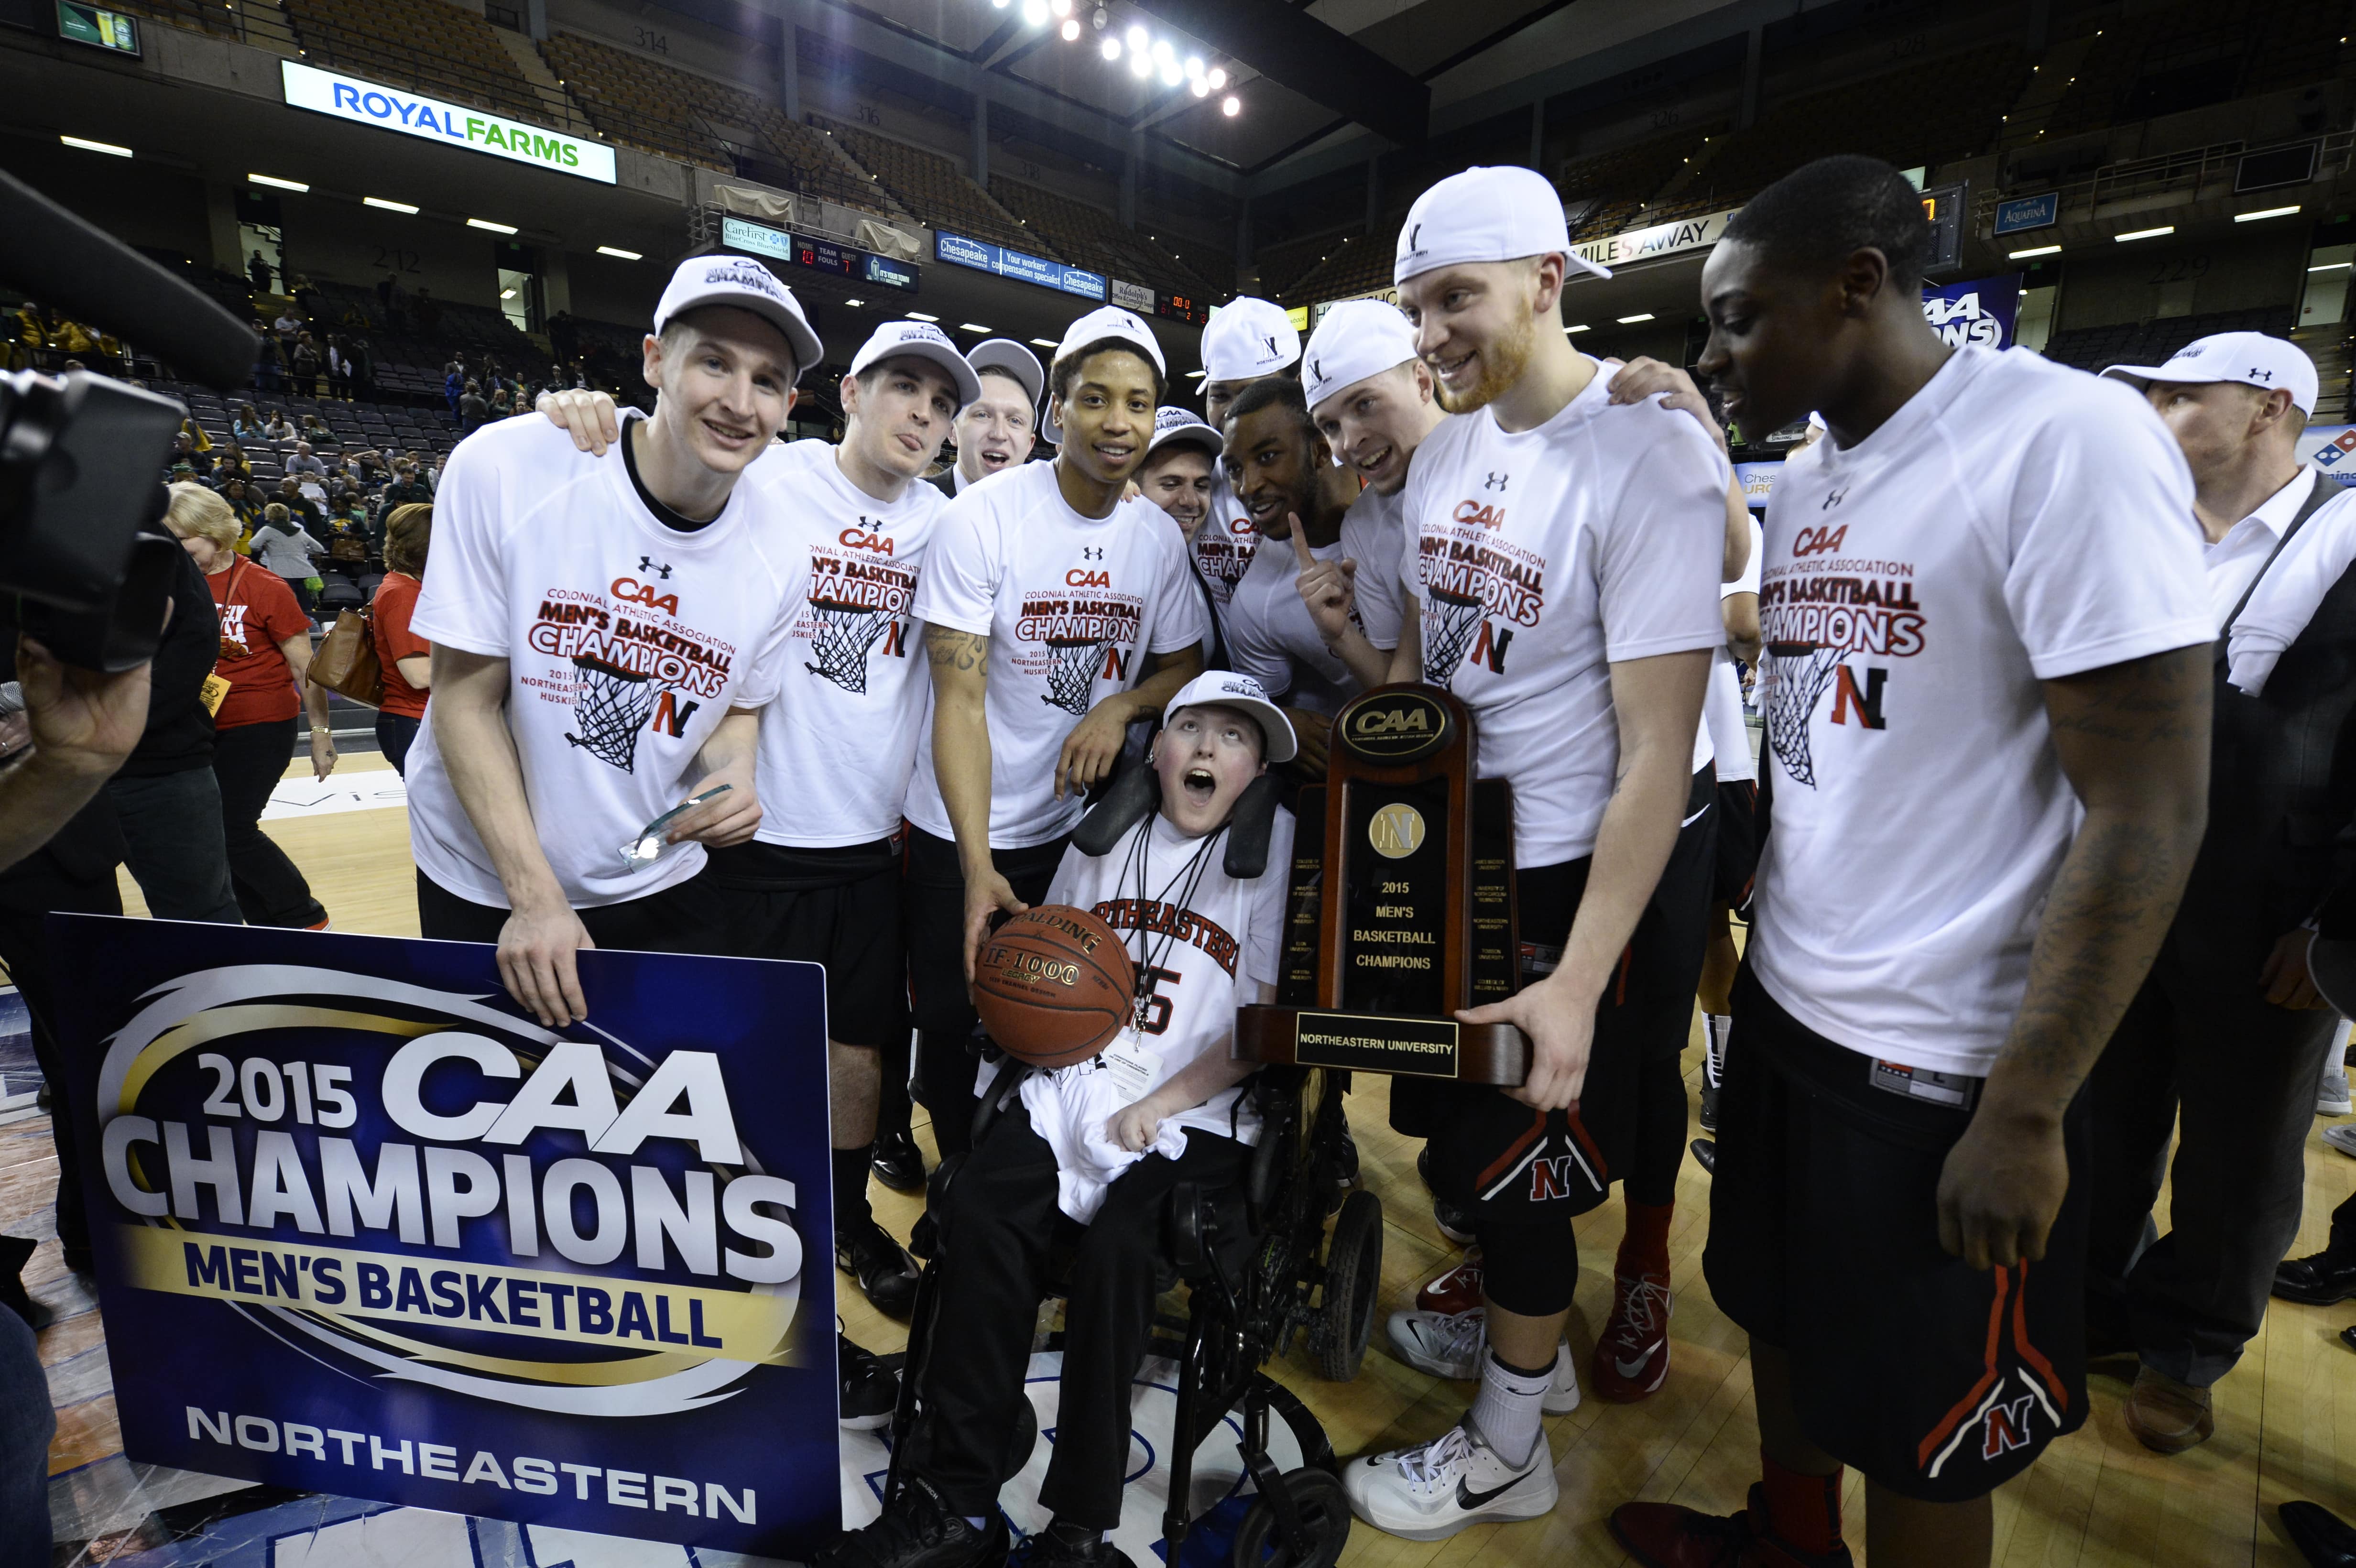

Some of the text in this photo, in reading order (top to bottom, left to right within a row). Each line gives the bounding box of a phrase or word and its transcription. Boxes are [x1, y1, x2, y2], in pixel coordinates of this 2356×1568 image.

[634, 26, 667, 54] 314
[855, 103, 880, 126] 316
[1649, 106, 1679, 131] 326
[2004, 205, 2046, 223] AQUAFINA
[725, 221, 768, 241] CareFirst
[1571, 219, 1710, 264] MILES AWAY
[725, 233, 788, 254] BlueCross BlueShield
[797, 240, 813, 251] HOME
[818, 247, 837, 257] TEAM
[940, 240, 988, 263] Chesapeake
[371, 245, 421, 273] 212
[818, 255, 838, 266] FOULS
[841, 251, 856, 261] GUEST
[843, 260, 850, 273] 7
[940, 251, 988, 269] Employers Insurance
[1006, 252, 1047, 272] Your workers'
[1034, 270, 1060, 285] specialist
[2149, 254, 2211, 284] 229
[1064, 273, 1103, 294] Chesapeake
[1064, 284, 1103, 299] Employers Insurance
[1119, 286, 1147, 301] Rudolph's
[1112, 293, 1123, 301] Office
[1126, 296, 1143, 306] Computer
[1186, 312, 1191, 320] 2
[1261, 337, 1277, 357] N
[1157, 410, 1182, 418] CAA
[1452, 500, 1506, 532] CAA
[839, 528, 894, 556] CAA
[1199, 534, 1232, 544] COLONIAL
[1422, 523, 1546, 569] COLONIAL ATHLETIC ASSOCIATION
[1793, 524, 1849, 558] CAA
[842, 550, 883, 564] ATHLETIC
[1197, 543, 1234, 558] MEN'S
[1419, 536, 1544, 595] MEN'S BASKETBALL
[1789, 560, 1826, 574] ATHLETIC
[1828, 559, 1914, 577] ASSOCIATION
[1066, 568, 1111, 588] CAA
[611, 577, 679, 617] CAA
[1025, 590, 1066, 599] COLONIAL
[1069, 590, 1102, 599] ATHLETIC
[1419, 555, 1545, 627] CHAMPIONS
[1789, 577, 1920, 610] BASKETBALL
[1021, 600, 1069, 617] MEN'S
[547, 588, 736, 655] COLONIAL ATHLETIC ASSOCIATION
[1015, 617, 1140, 643] CHAMPION
[1760, 606, 1928, 657] HAMPIONS
[537, 600, 732, 675] MEN'S BASKETBALL
[883, 620, 910, 658] N
[1470, 620, 1514, 675] N
[527, 621, 729, 699] CHAMPIONS
[1011, 658, 1062, 666] NORTHEASTERN
[1102, 647, 1133, 681] N
[521, 676, 589, 692] NORTHEASTERN
[549, 669, 573, 680] 2015
[540, 692, 578, 706] HUSKIES
[1830, 663, 1889, 730] N
[652, 690, 700, 739] N
[1356, 708, 1429, 734] CAA
[1379, 813, 1415, 849] N
[1382, 882, 1409, 893] 2015
[1375, 906, 1414, 918] MEN'S
[1353, 930, 1436, 944] BASKETBALL
[1356, 954, 1431, 969] CHAMPIONS
[1002, 968, 1041, 984] LEGACY
[1002, 980, 1028, 991] CHANNEL
[1300, 1033, 1453, 1055] NORTHEASTERN UNIVERSITY
[197, 1031, 745, 1166] 2015 CAA
[1530, 1155, 1572, 1202] N
[102, 1115, 803, 1285] CHAMPIONS
[183, 1241, 723, 1350] MEN'S BASKETBALL
[1983, 1394, 2034, 1461] N
[185, 1406, 756, 1525] NORTHEASTERN
